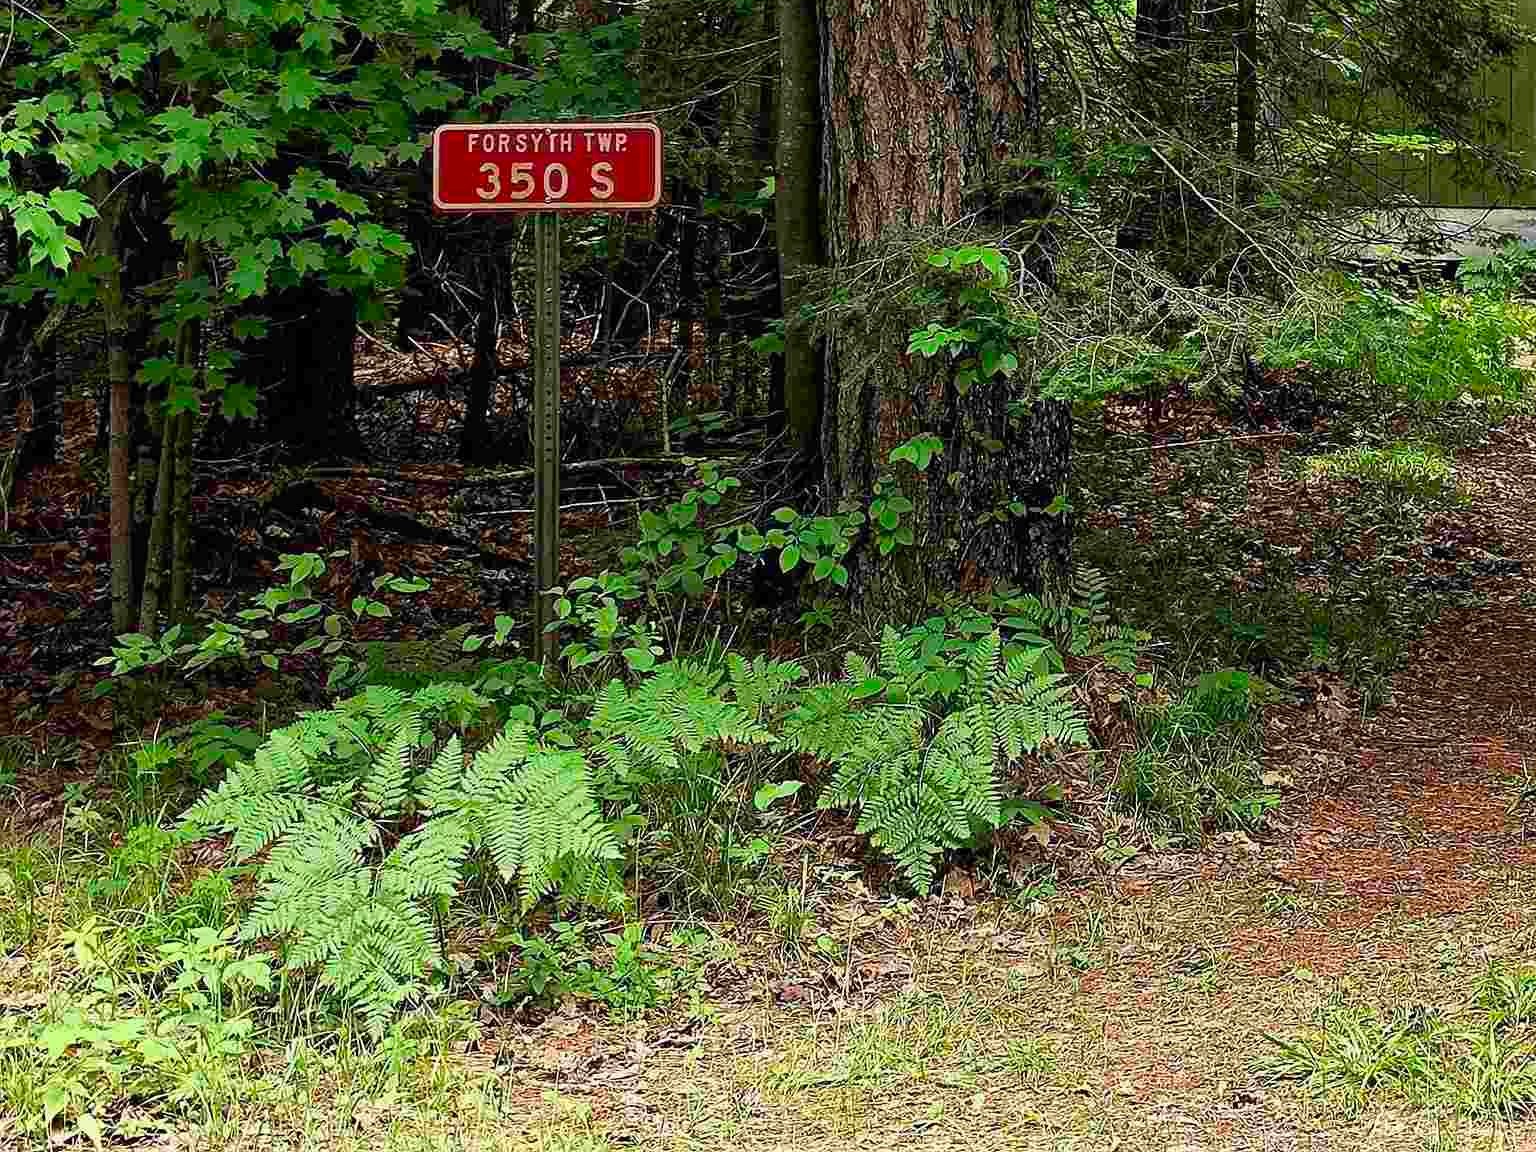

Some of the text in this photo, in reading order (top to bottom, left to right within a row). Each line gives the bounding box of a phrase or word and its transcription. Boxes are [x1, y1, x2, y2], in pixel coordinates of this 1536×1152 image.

[467, 132, 572, 153] FORSYTH
[475, 161, 615, 200] 350 S
